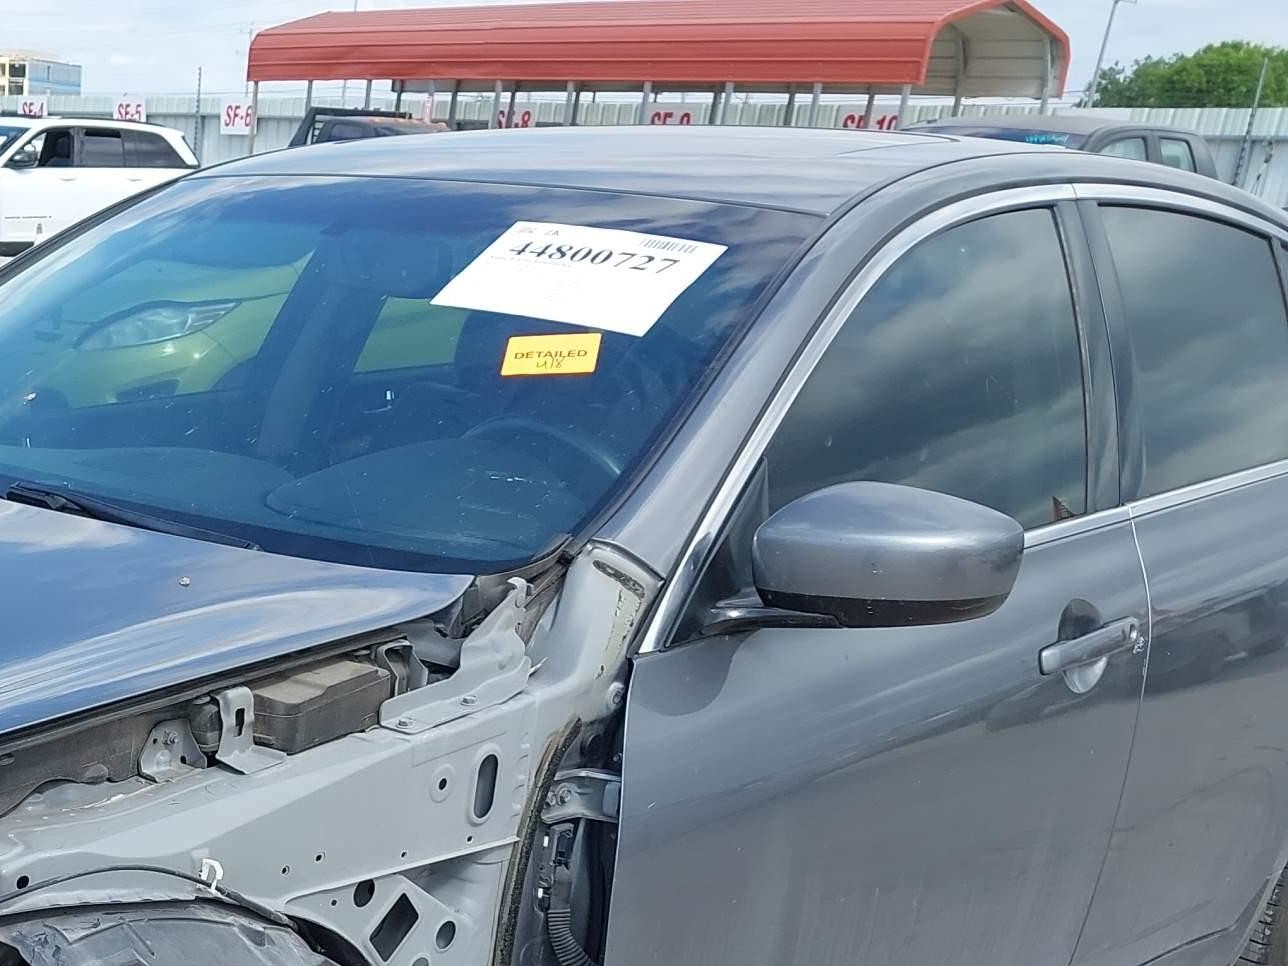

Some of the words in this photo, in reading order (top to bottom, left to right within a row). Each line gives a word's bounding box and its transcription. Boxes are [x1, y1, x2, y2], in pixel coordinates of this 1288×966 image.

[224, 104, 254, 128] SF-6
[509, 241, 680, 274] 44800727
[514, 349, 588, 360] DETAILED
